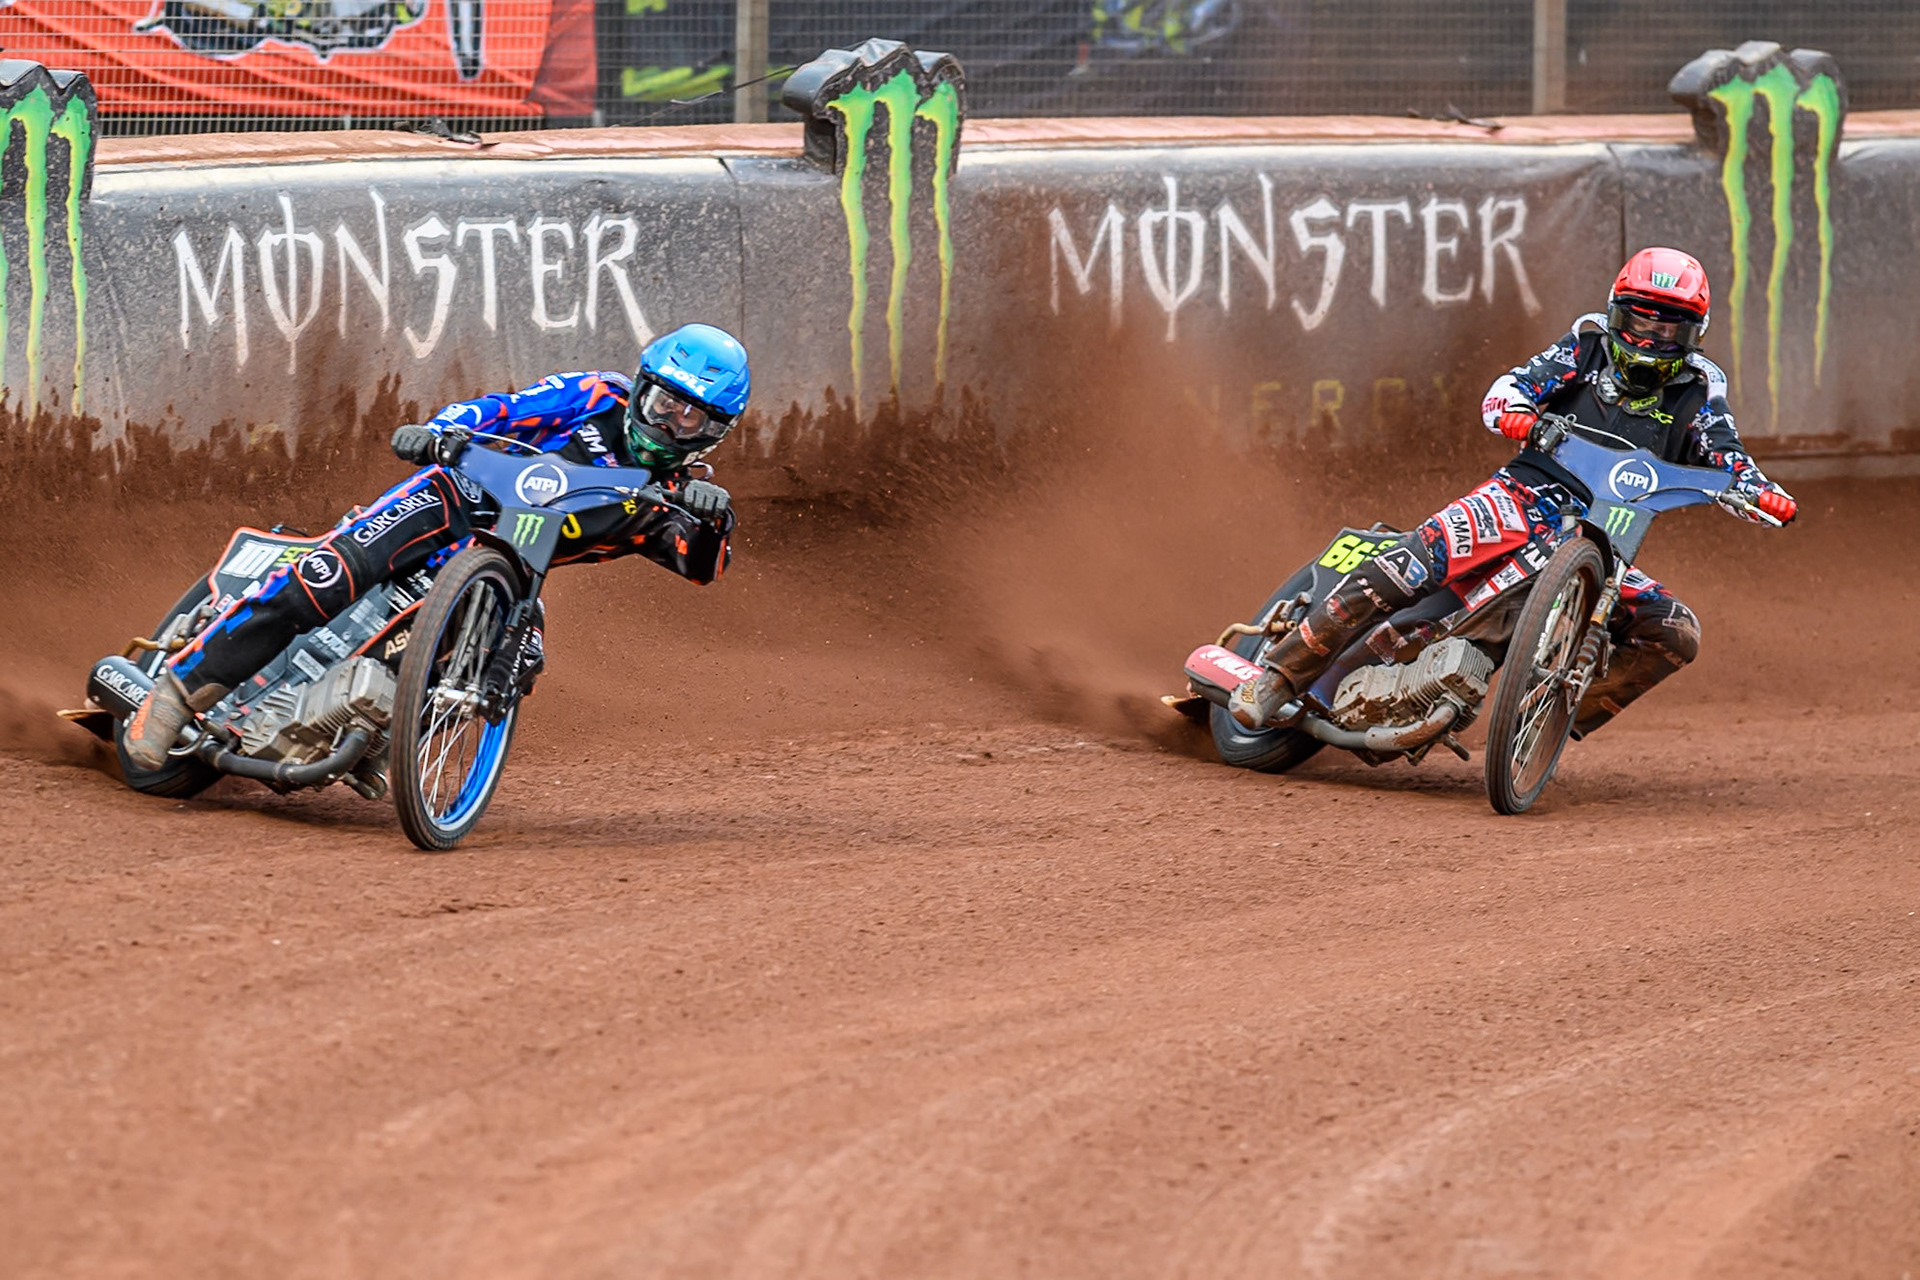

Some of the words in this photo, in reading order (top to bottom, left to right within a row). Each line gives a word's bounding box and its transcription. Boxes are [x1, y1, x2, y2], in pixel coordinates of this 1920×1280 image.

[1047, 173, 1542, 342] MONSTER
[174, 186, 655, 375] MONSTER
[523, 476, 559, 494] ATPI
[1616, 471, 1650, 490] ATPI
[353, 488, 440, 544] GARCAREK
[220, 540, 288, 579] 101
[307, 556, 333, 580] ATPI
